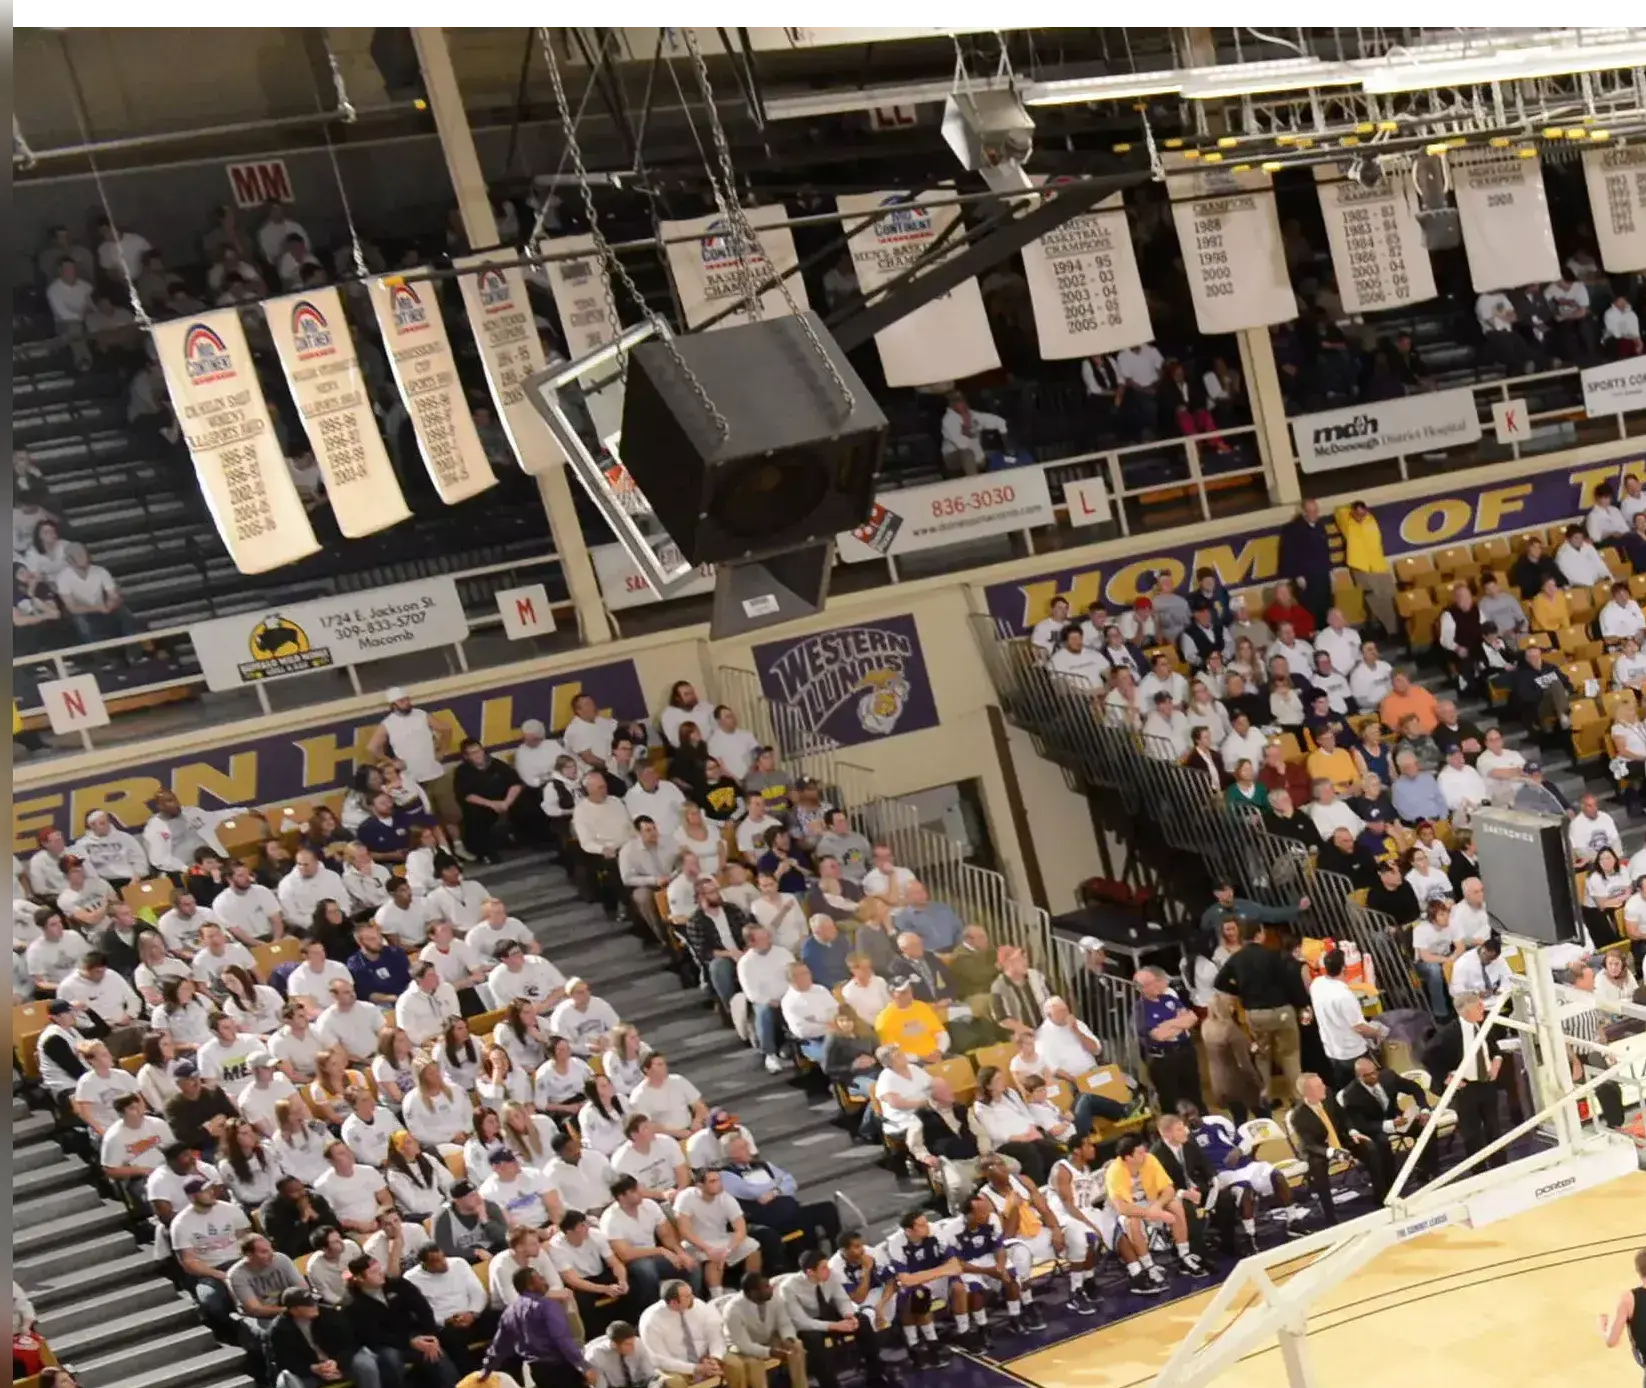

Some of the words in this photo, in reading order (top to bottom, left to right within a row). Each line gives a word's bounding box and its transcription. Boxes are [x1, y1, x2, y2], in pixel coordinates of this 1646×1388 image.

[875, 109, 914, 129] LL
[231, 163, 292, 202] MM
[874, 220, 932, 237] CONTINENT
[1053, 259, 1083, 276] 1994
[1057, 273, 1087, 290] 2002
[1586, 376, 1627, 394] SPORTS
[1506, 410, 1519, 434] K
[1313, 438, 1380, 458] McDonough
[930, 484, 1017, 520] 836-3030
[1078, 489, 1097, 516] L
[1021, 522, 1345, 628] HOM
[1400, 483, 1532, 545] OF
[514, 598, 537, 626] M
[357, 630, 414, 651] Macomb
[769, 626, 911, 706] WESTERN
[63, 690, 88, 720] N
